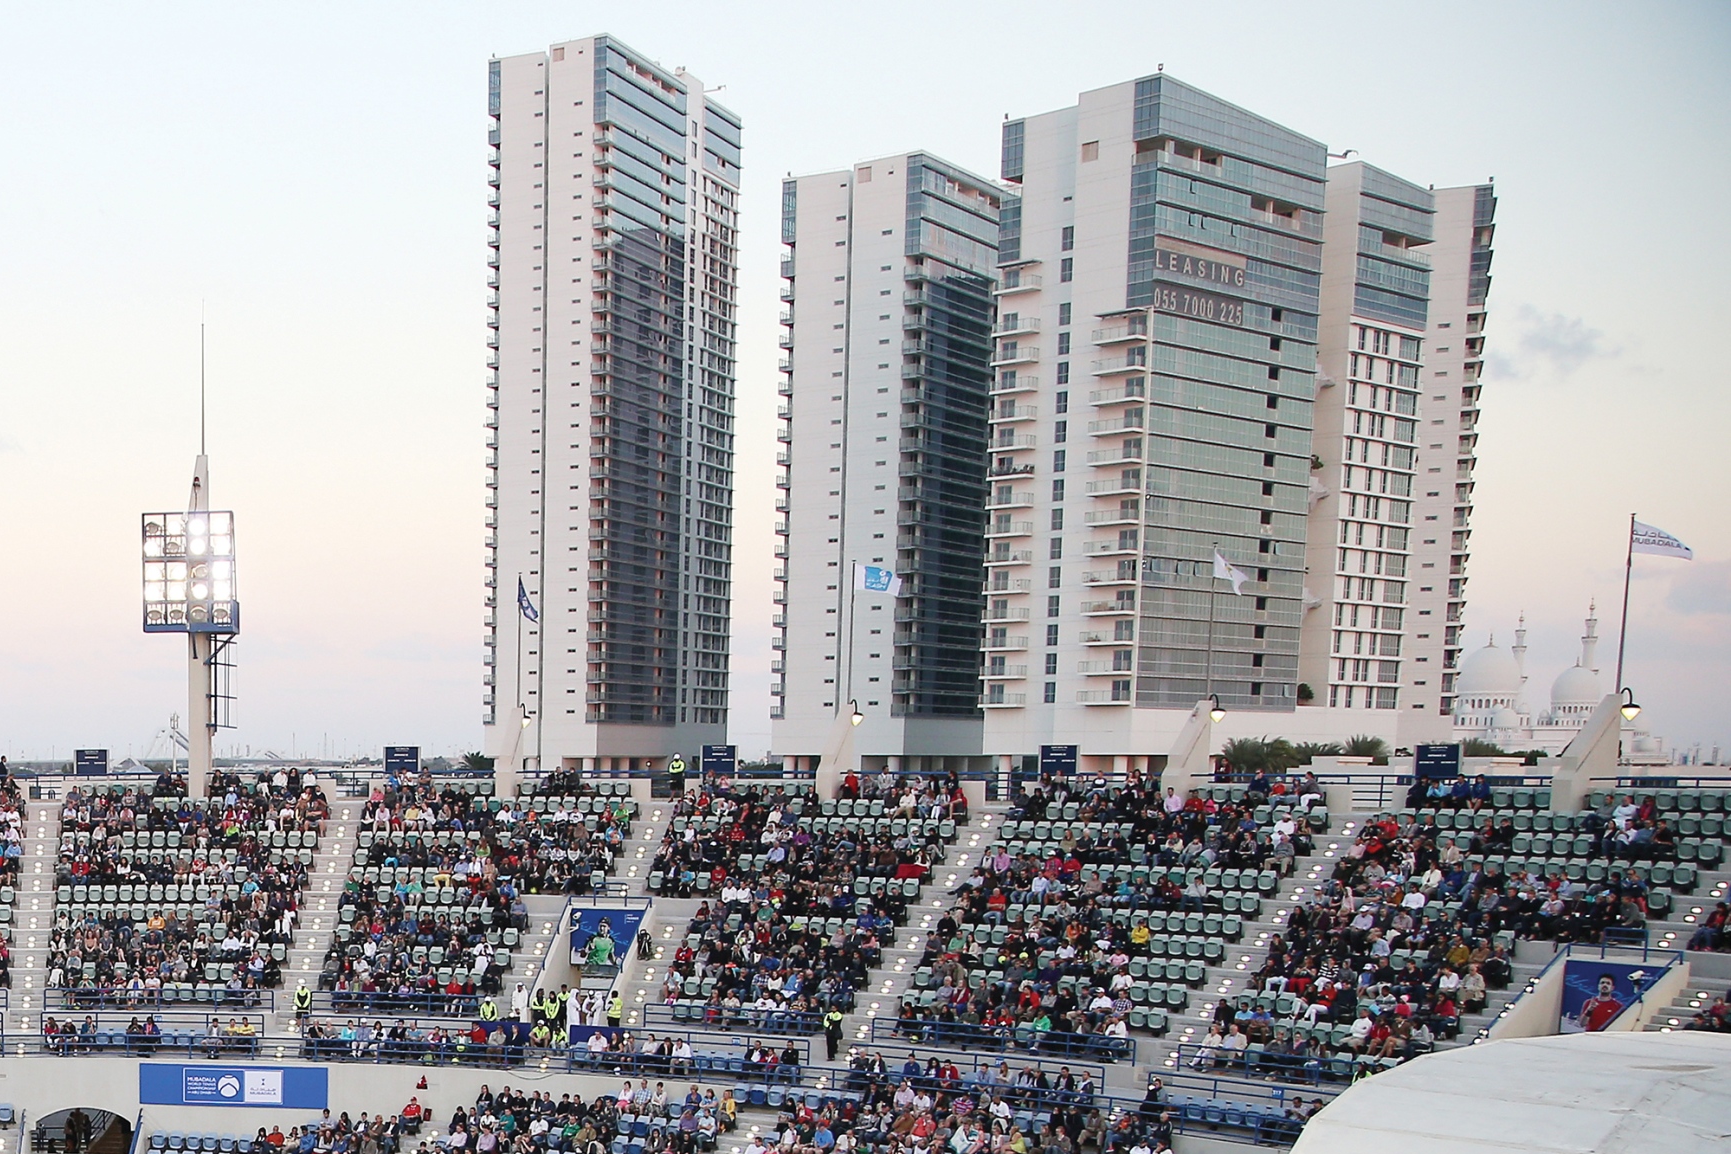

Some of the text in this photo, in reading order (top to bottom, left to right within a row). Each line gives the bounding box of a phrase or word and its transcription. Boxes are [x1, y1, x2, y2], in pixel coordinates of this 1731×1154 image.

[1155, 250, 1244, 287] LEASING
[1153, 287, 1243, 325] 055 7000 225
